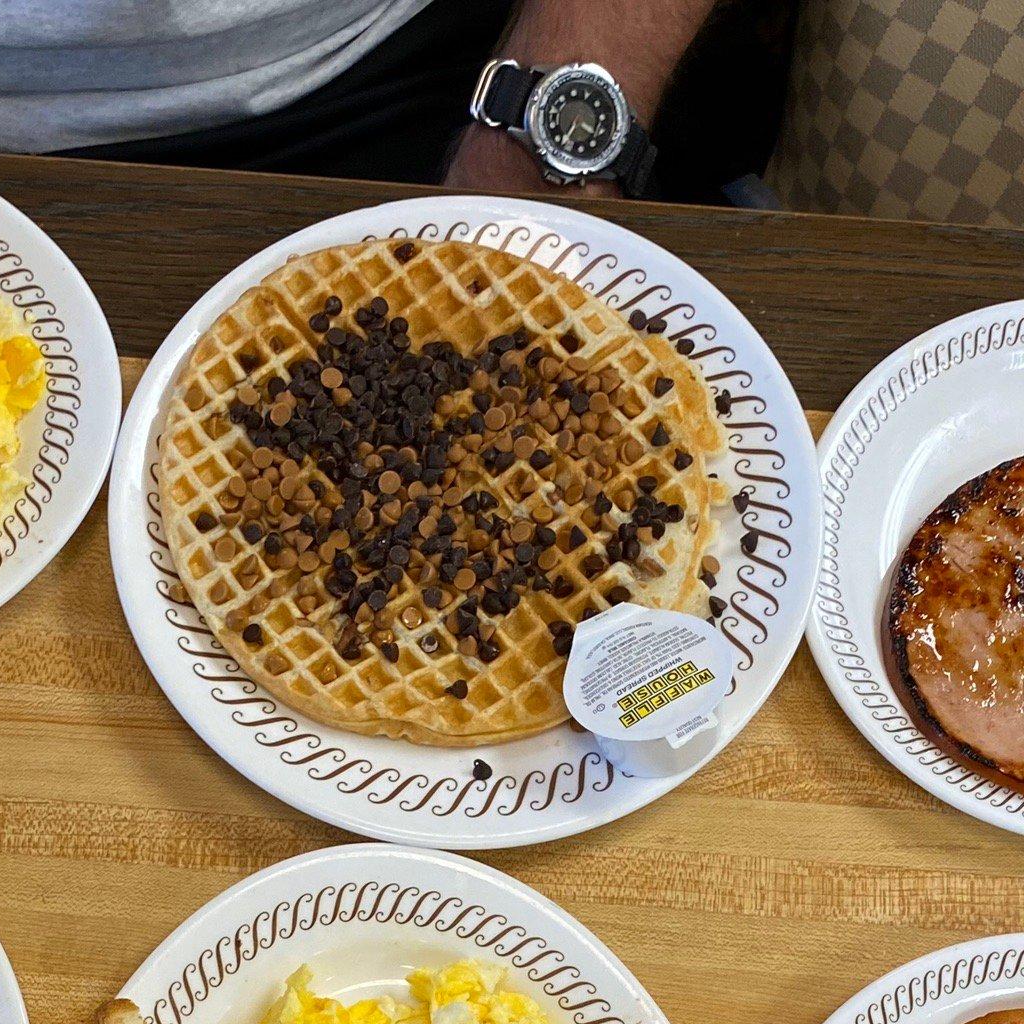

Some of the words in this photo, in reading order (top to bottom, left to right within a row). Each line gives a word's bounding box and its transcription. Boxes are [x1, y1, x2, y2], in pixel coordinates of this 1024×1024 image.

[648, 656, 682, 678] WHIPPED
[616, 674, 647, 696] SPREAD
[619, 662, 696, 710] HOUSE
[621, 670, 713, 726] WAFFLE
